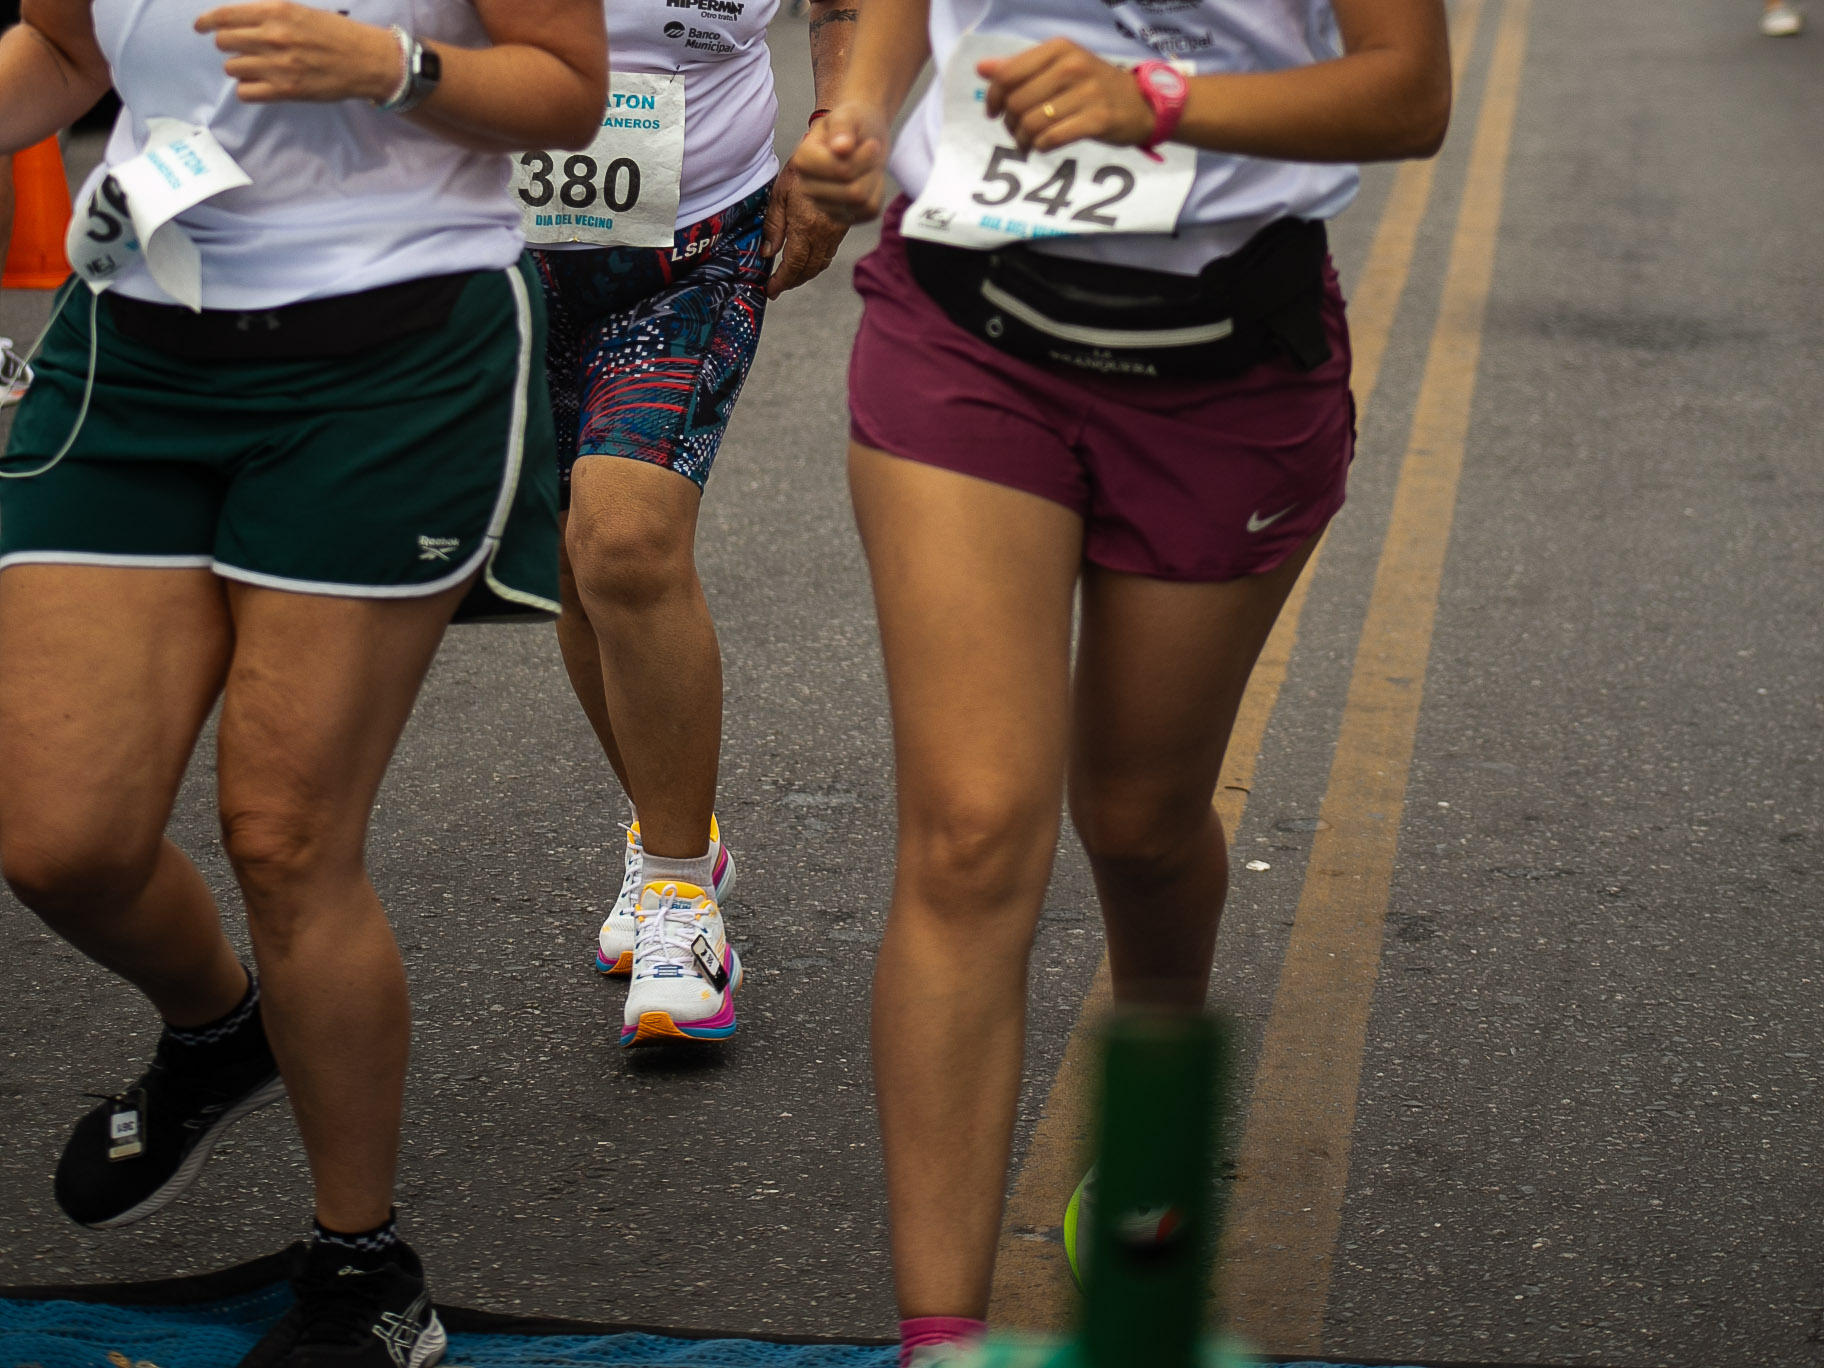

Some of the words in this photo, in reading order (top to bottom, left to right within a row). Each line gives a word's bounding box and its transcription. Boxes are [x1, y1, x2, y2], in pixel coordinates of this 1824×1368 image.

[701, 11, 717, 19] Otro
[688, 27, 721, 41] Banco
[685, 38, 736, 53] Municipal
[517, 150, 641, 213] 380
[972, 144, 1136, 228] 542
[535, 214, 553, 227] DIA
[555, 214, 573, 226] DEL
[575, 215, 614, 230] VECINO
